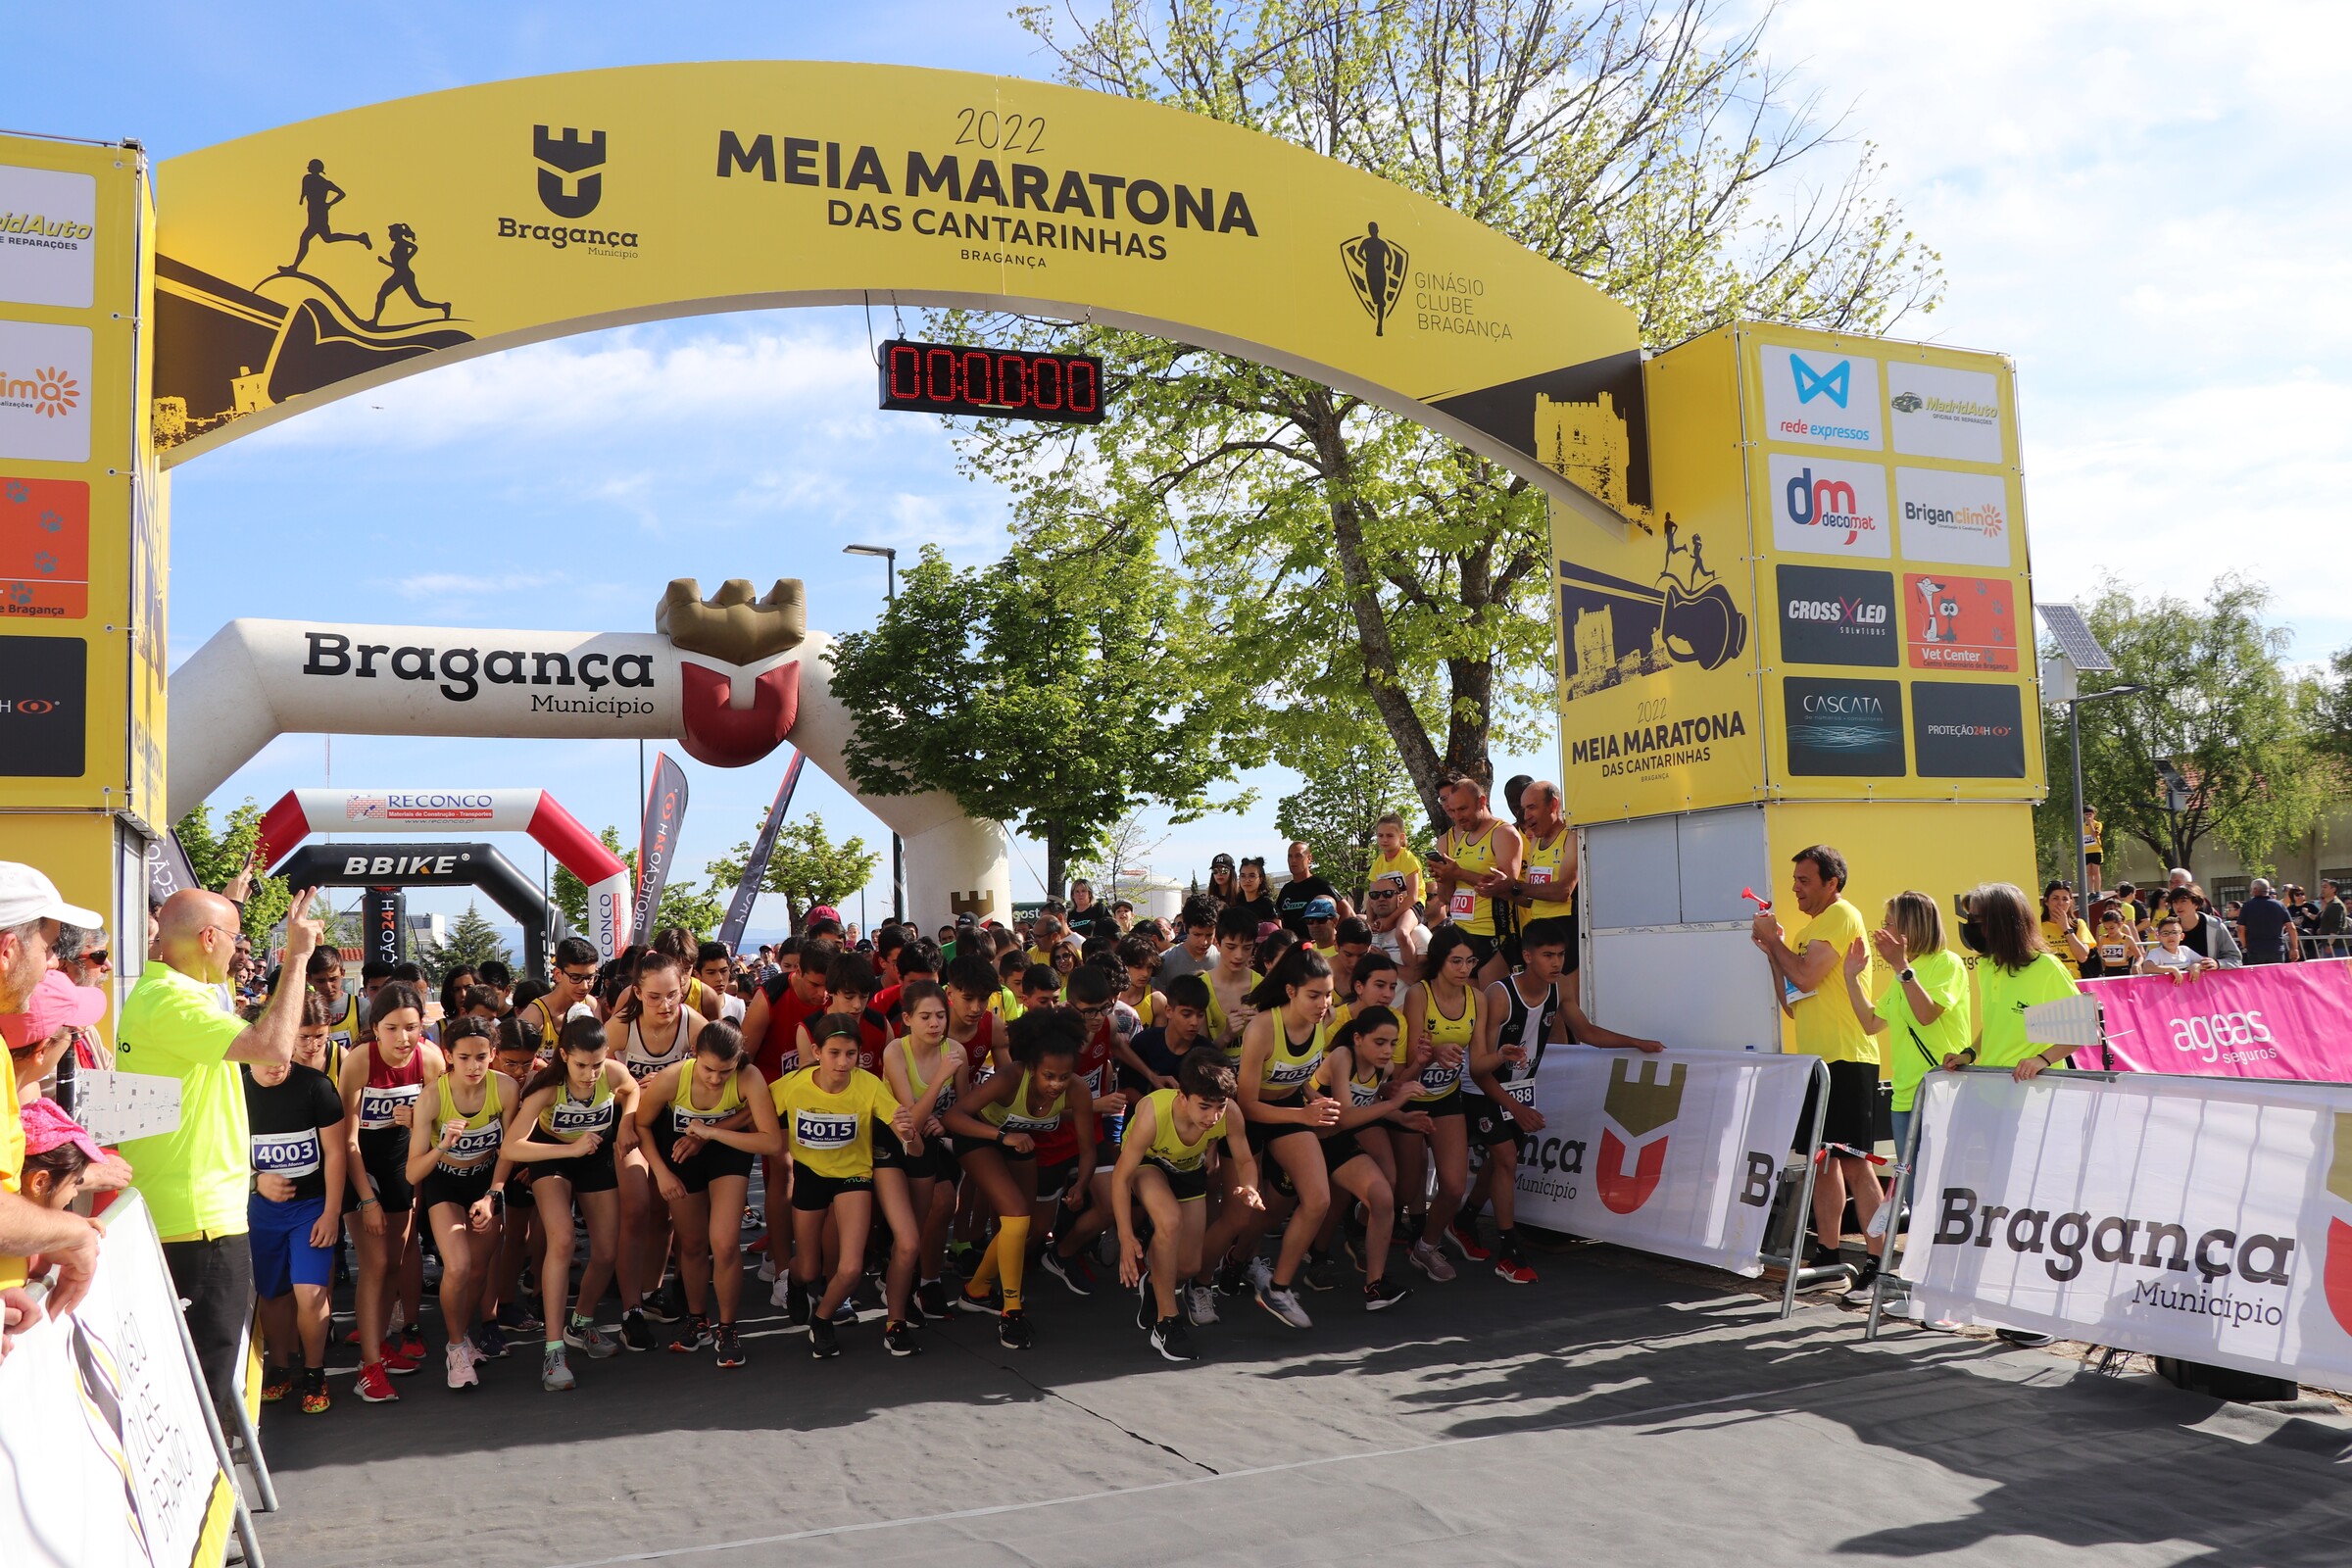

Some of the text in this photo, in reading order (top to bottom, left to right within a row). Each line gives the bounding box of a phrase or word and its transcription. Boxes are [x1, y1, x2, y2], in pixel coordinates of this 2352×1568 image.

[955, 107, 1047, 153] 2022
[716, 129, 1259, 237] MEIA MARATONA
[0, 211, 92, 241] idAuto
[497, 217, 639, 251] Bragança
[827, 199, 1167, 261] DAS CANTARINHAS
[8, 235, 78, 251] REPARAÇÕES
[588, 245, 639, 260] Município
[960, 249, 1048, 269] BRAGANÇA
[1414, 271, 1484, 296] GINÁSIO
[1416, 293, 1474, 315] CLUBE
[1418, 313, 1512, 342] BRAGANÇA
[0, 371, 61, 402] ima
[890, 345, 1096, 413] 00:00:00
[1926, 396, 1997, 417] MadridAuto
[1780, 418, 1869, 440] rede expressos
[1823, 511, 1876, 530] decomat
[8, 604, 66, 616] Bragança
[1922, 648, 1981, 662] Vet Center
[303, 631, 655, 702] Bragança
[530, 694, 655, 718] Município
[1637, 697, 1667, 724] 2022
[1803, 695, 1884, 714] CASCATA
[1572, 710, 1746, 764] MEIA MARATONA
[1928, 723, 1990, 738] PROTEÇÃO24H
[1601, 747, 1711, 778] DAS CANTARINHAS
[1641, 772, 1669, 783] BRAGANÇA
[388, 795, 492, 808] RECONCO
[343, 856, 457, 875] BBIKE
[1012, 907, 1041, 922] gost
[380, 899, 398, 965] ÇÃO24H
[2170, 1008, 2272, 1063] ageas
[2222, 1044, 2278, 1066] seguros
[558, 1107, 610, 1124] 4037
[800, 1121, 852, 1137] 4015
[258, 1141, 314, 1163] 4003
[437, 1161, 469, 1176] NIKE
[1933, 1186, 2296, 1286] Bragança
[2132, 1279, 2283, 1328] Município
